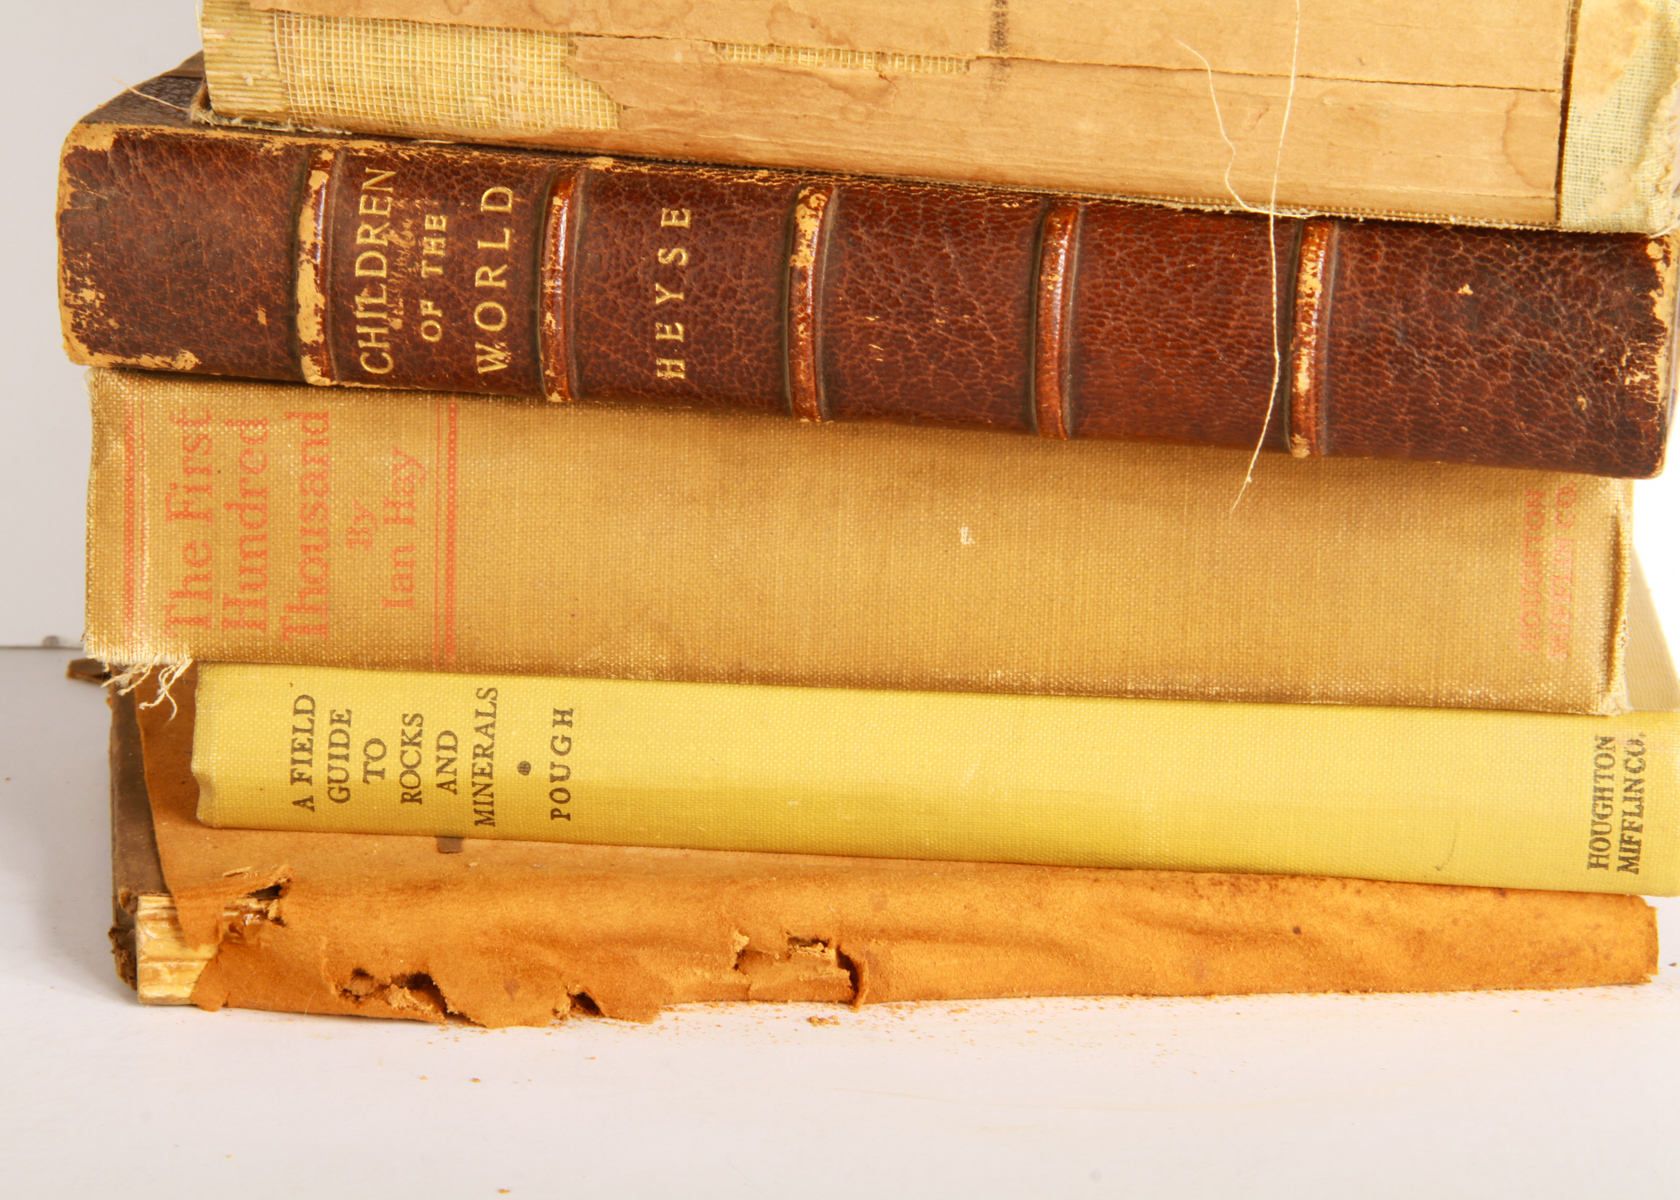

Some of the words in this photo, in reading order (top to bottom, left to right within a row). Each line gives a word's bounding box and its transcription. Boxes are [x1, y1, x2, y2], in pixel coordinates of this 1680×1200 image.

[354, 166, 396, 375] CHILDREN
[420, 213, 448, 277] THE
[473, 185, 515, 375] WORLD
[655, 206, 692, 380] HEYSE
[420, 299, 443, 343] OF
[164, 408, 214, 526] First
[382, 445, 427, 528] Hay
[221, 416, 269, 634] Hundred
[279, 408, 330, 643] Thousand
[345, 499, 379, 551] By
[1518, 488, 1546, 654] HOUGHTON
[163, 540, 214, 638] The
[381, 543, 416, 611] Ian
[289, 694, 316, 786] FIELD
[327, 708, 353, 804] GUIDE
[362, 737, 387, 785] TO
[399, 712, 424, 805] ROCKS
[435, 730, 458, 796] AND
[471, 686, 499, 827] MINERALS
[549, 707, 574, 821] POUGH
[292, 795, 315, 812] A
[1586, 734, 1617, 871] HOUGHTON
[1616, 775, 1646, 876] MIFFLIN
